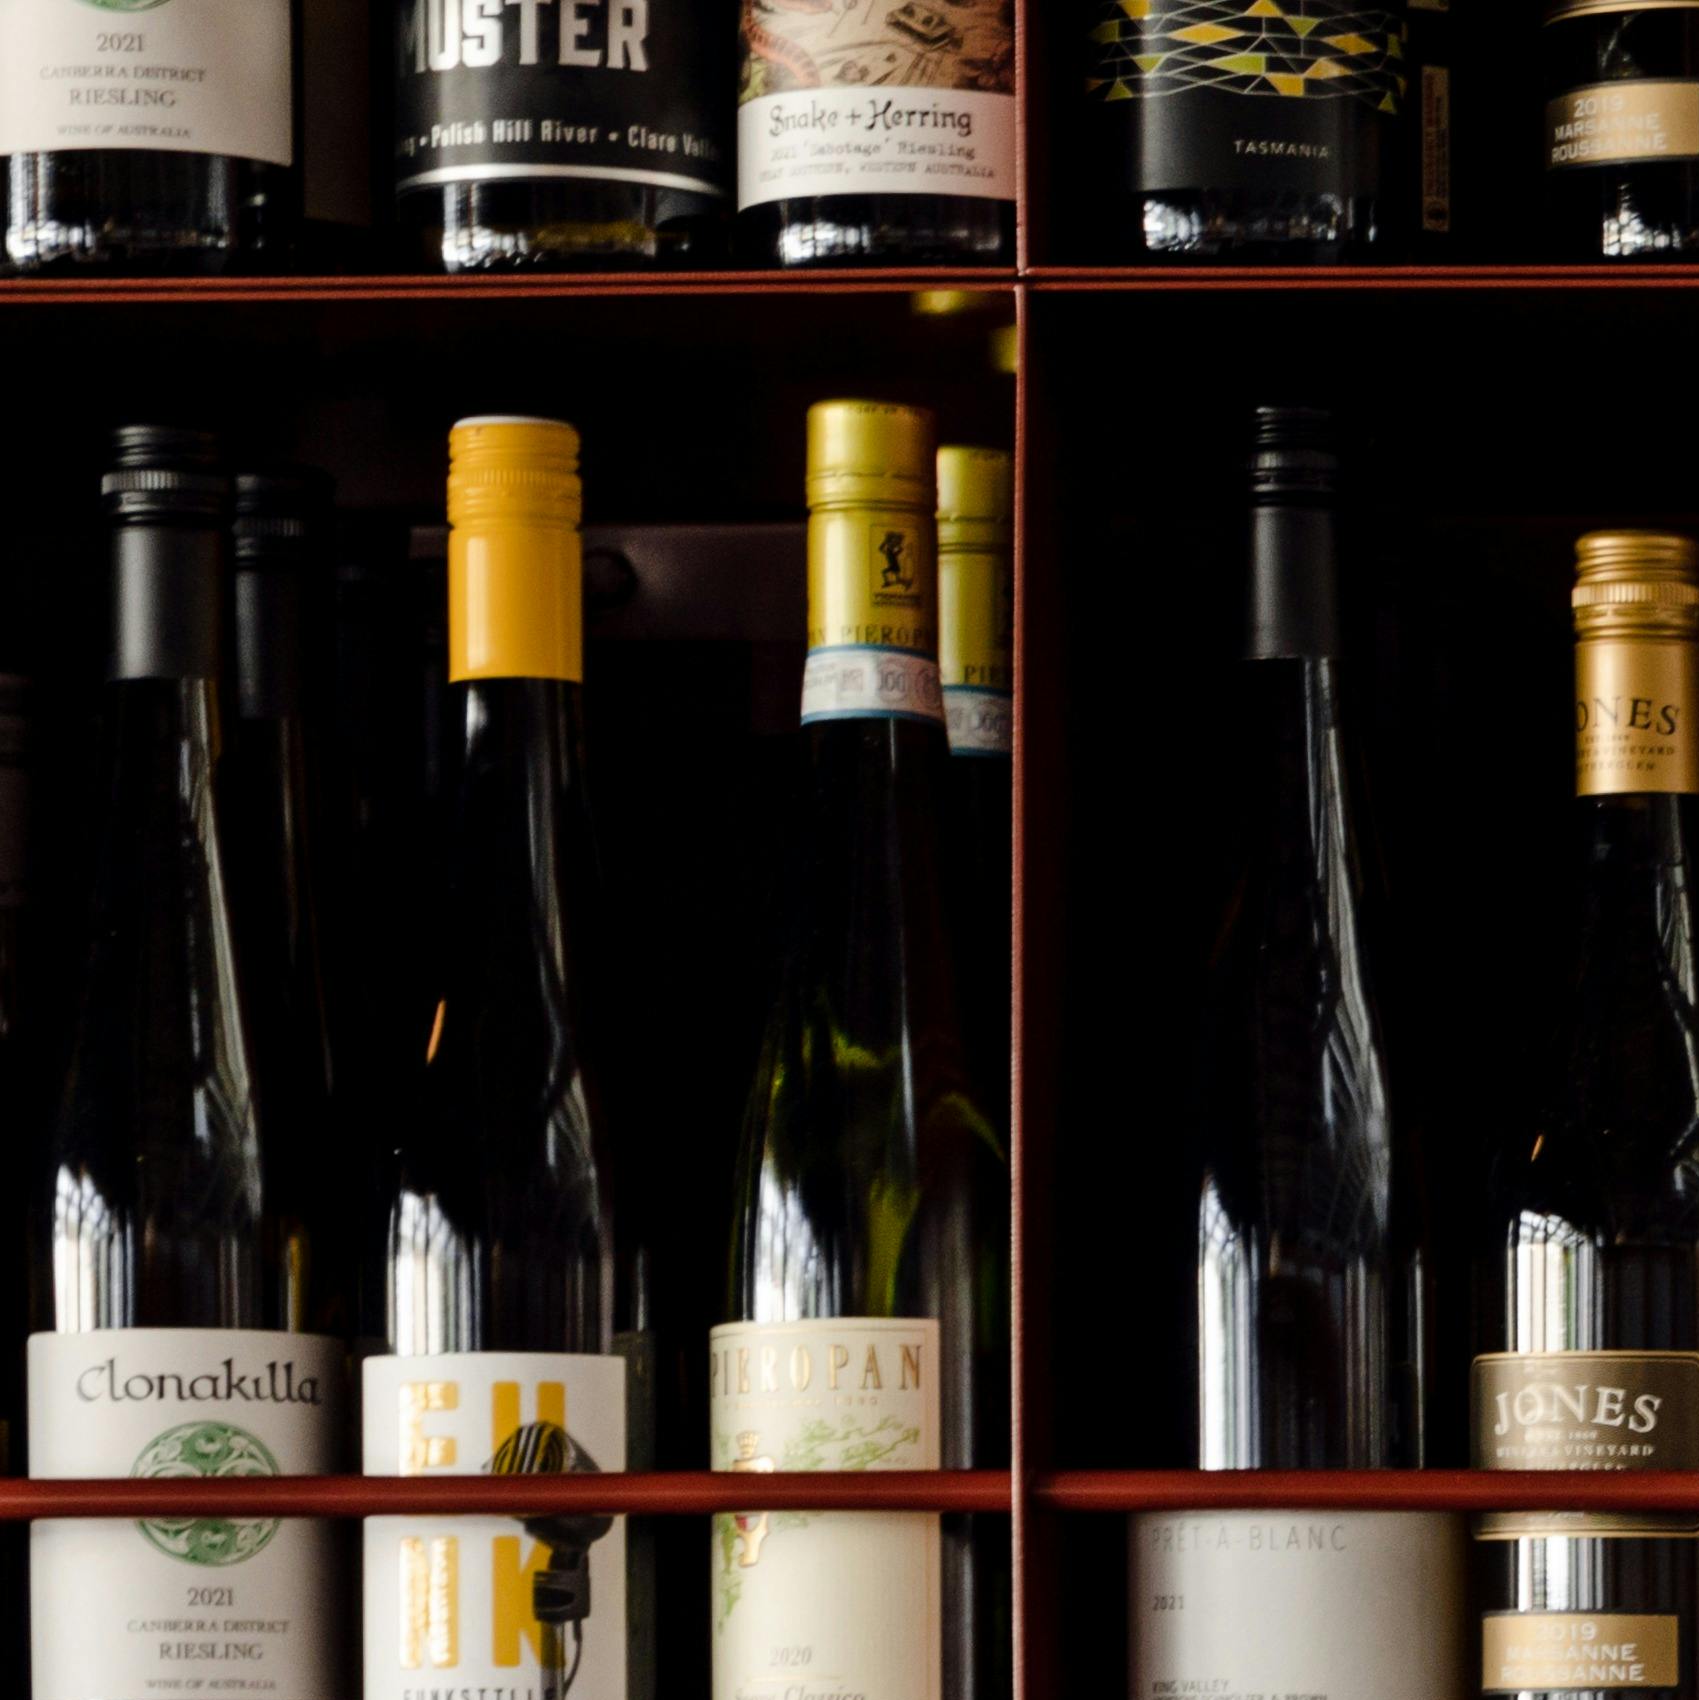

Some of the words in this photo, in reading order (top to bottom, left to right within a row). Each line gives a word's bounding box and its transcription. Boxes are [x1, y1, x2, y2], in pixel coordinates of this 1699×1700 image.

[96, 33, 145, 52] 2021
[133, 65, 206, 82] DISTRICT
[70, 87, 176, 107] RIESLING
[768, 104, 838, 136] Snake
[864, 100, 973, 136] Herring
[431, 122, 487, 148] Polish
[492, 119, 532, 142] Hill
[541, 119, 598, 142] River
[627, 125, 676, 153] Clare
[898, 141, 976, 159] Riesling
[1233, 139, 1330, 160] TASMANIA
[923, 162, 996, 179] AUSTRALIA
[711, 1344, 922, 1398] PIEROPAN
[77, 1357, 321, 1406] Clonakilla
[1494, 1383, 1663, 1437] JONES
[1564, 1444, 1656, 1457] VINEYARD
[187, 1586, 234, 1607] 2021
[127, 1618, 218, 1633] CANBERRA
[223, 1618, 290, 1633] DISTRICT
[1534, 1621, 1598, 1642] 2019
[159, 1642, 264, 1661] RIESLING
[769, 1646, 813, 1667] 2020
[1507, 1643, 1639, 1663] MARSANNE
